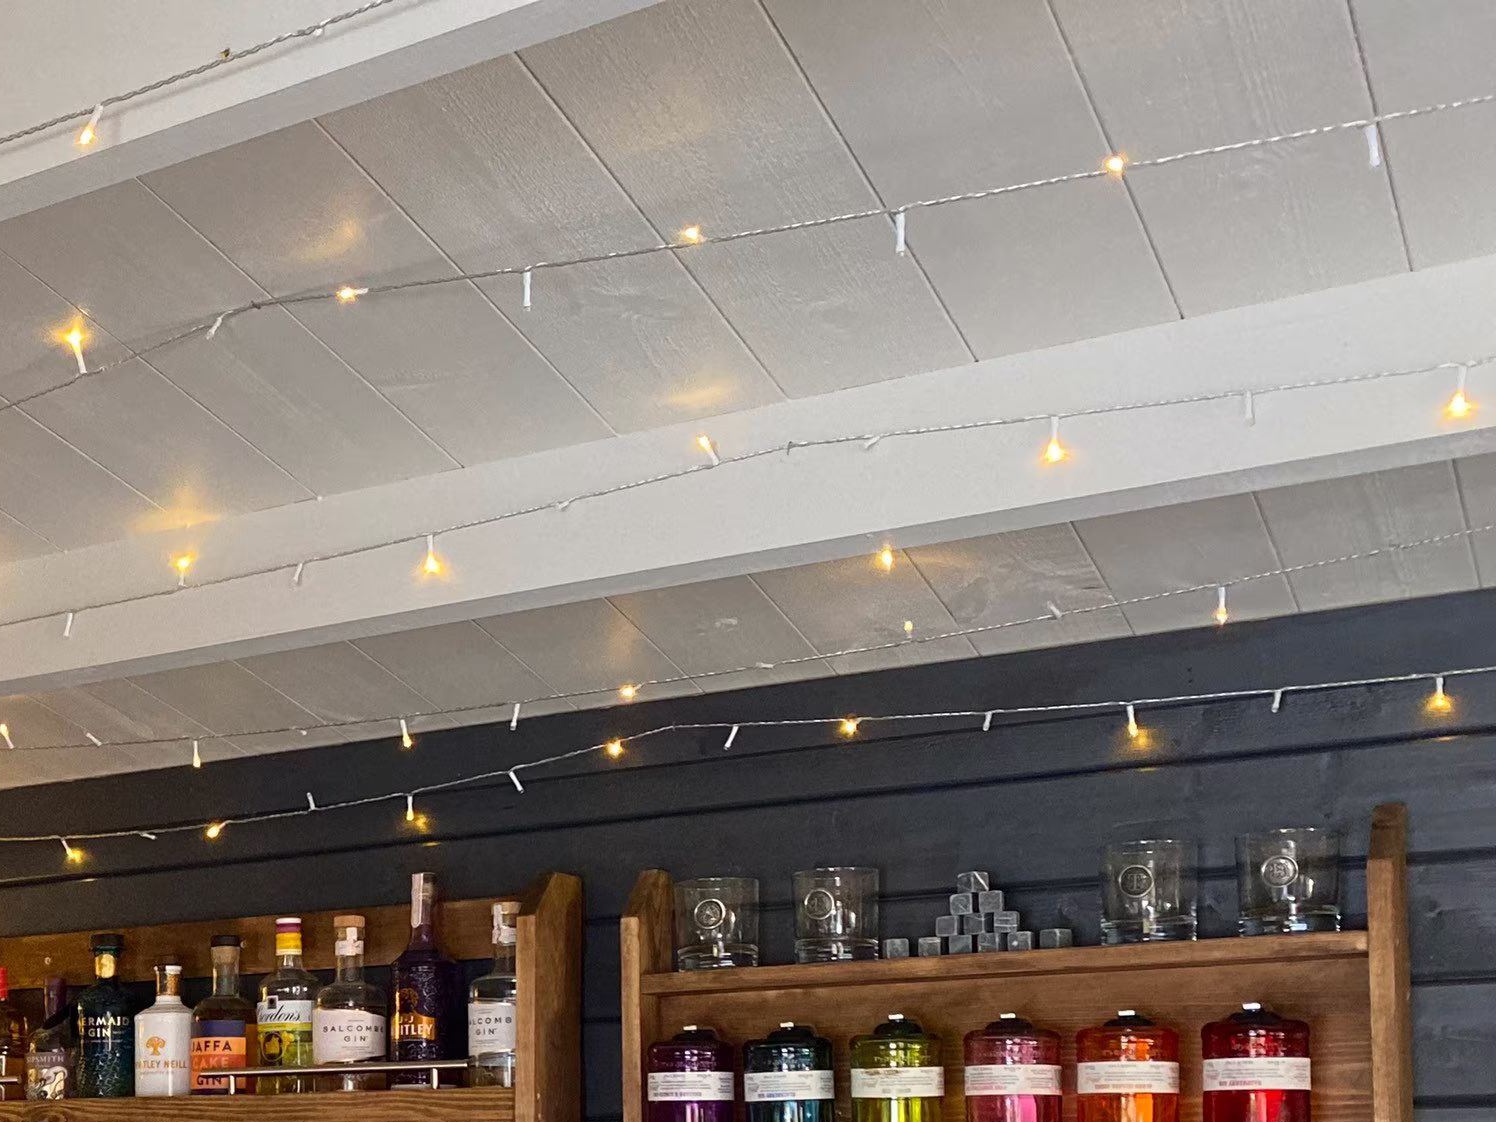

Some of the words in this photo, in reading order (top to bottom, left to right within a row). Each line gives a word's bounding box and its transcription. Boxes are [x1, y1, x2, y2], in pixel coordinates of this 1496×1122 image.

[88, 1028, 111, 1038] GIN
[475, 1028, 495, 1036] GIN
[343, 1035, 366, 1043] GIN
[164, 1060, 187, 1069] NEILL
